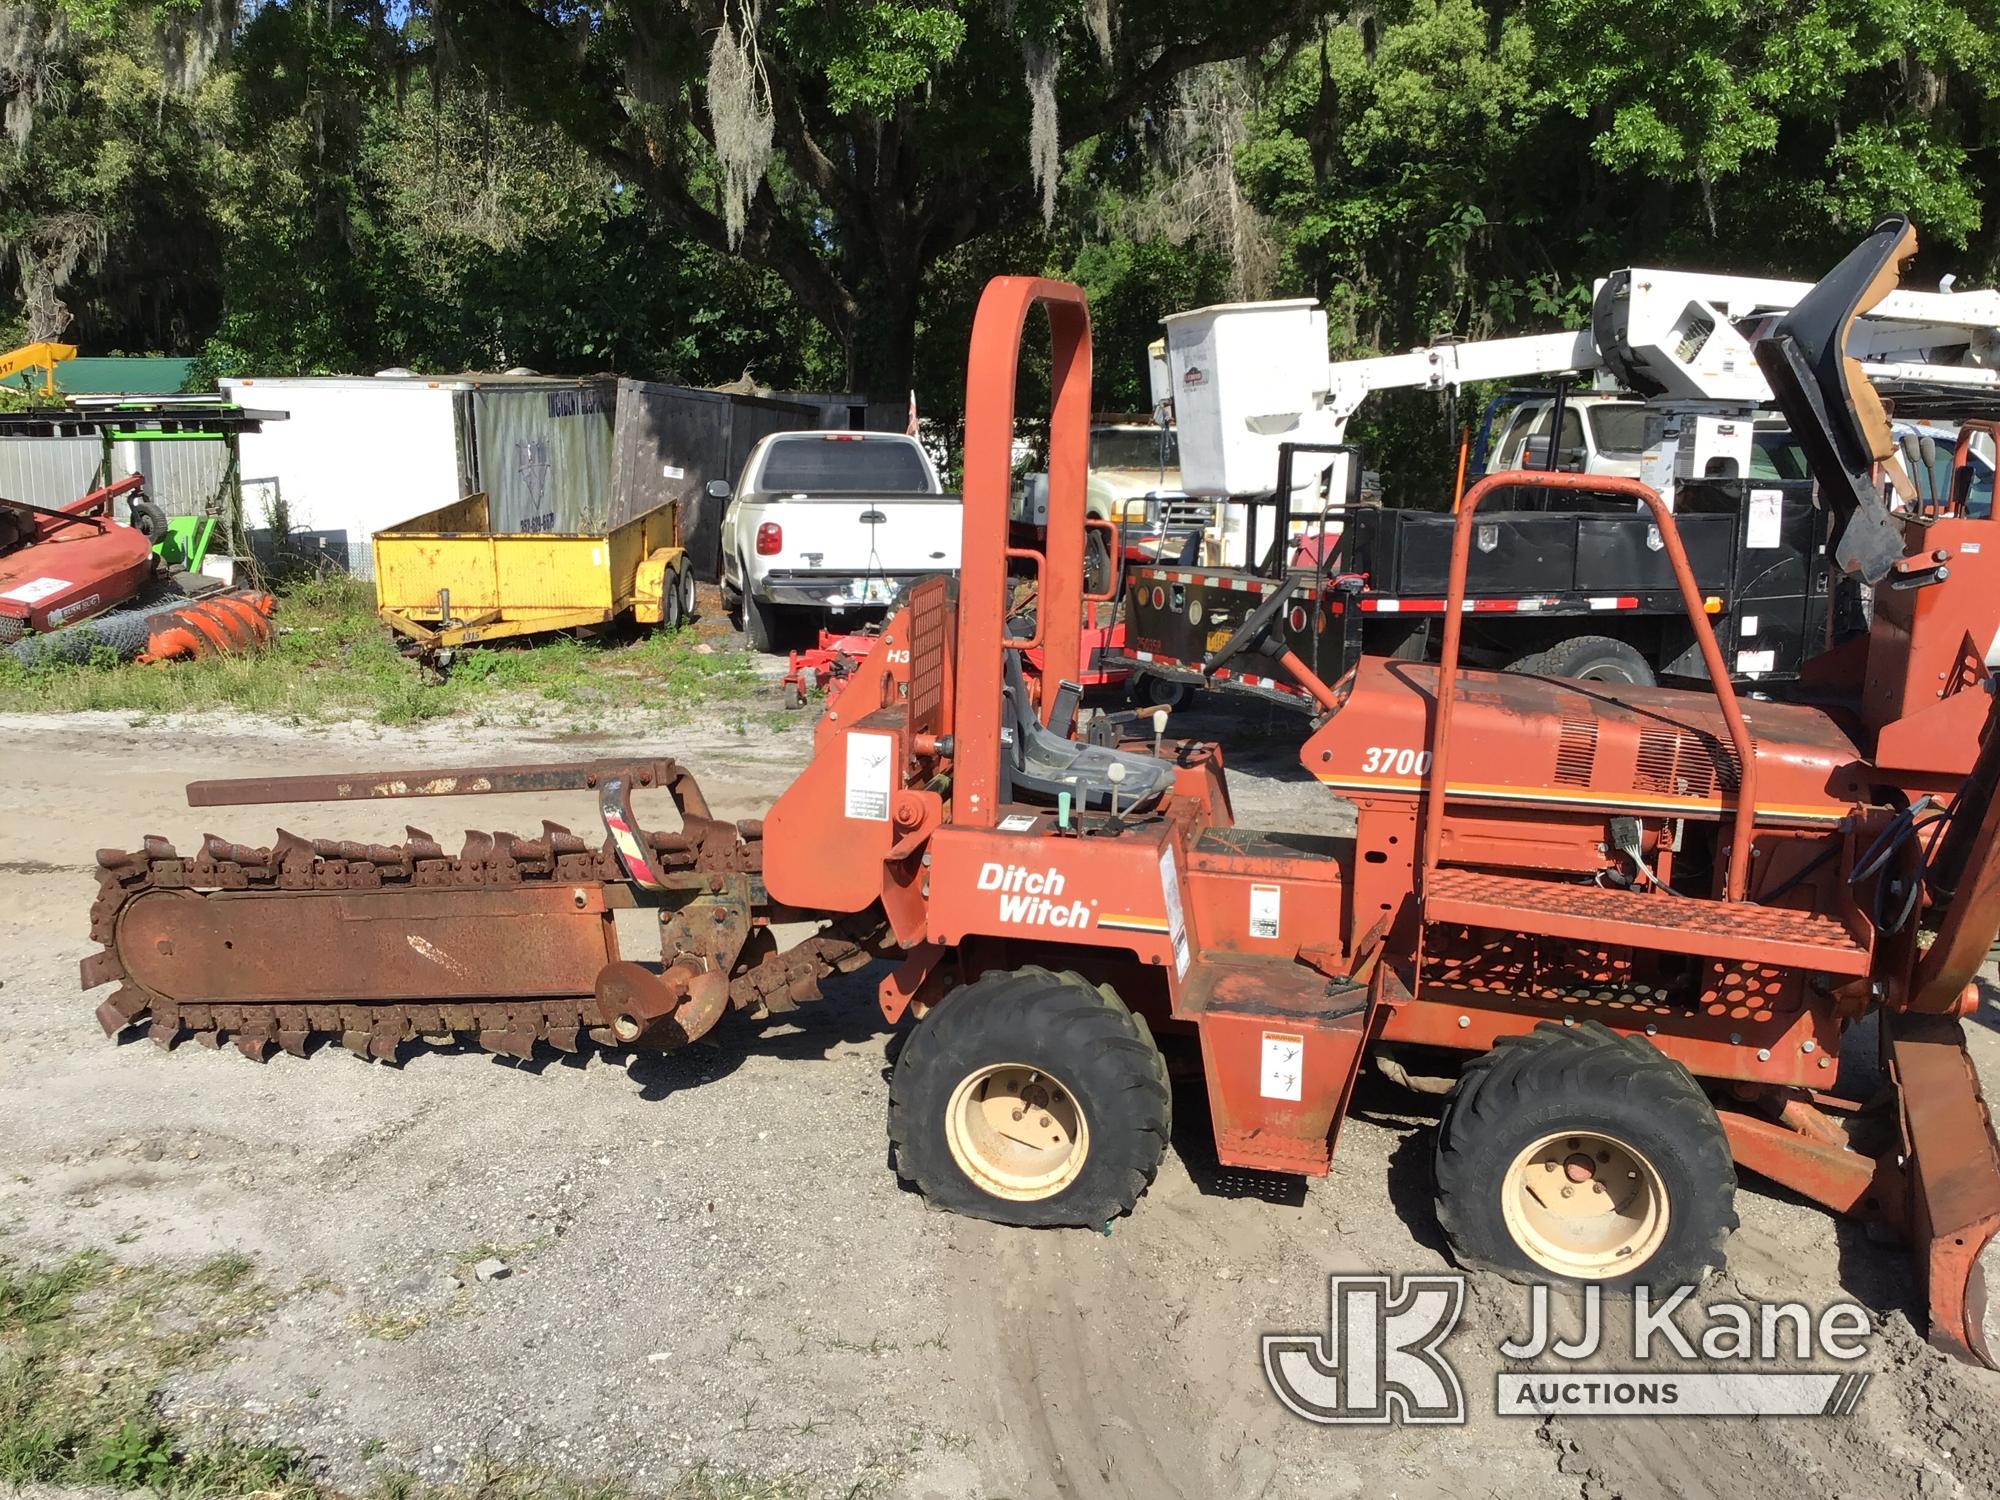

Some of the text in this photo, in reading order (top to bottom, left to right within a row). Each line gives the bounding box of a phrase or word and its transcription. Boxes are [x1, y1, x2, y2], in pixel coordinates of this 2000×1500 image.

[1362, 747, 1433, 776] 3700
[977, 863, 1065, 895] Ditch
[1000, 894, 1090, 928] Witch
